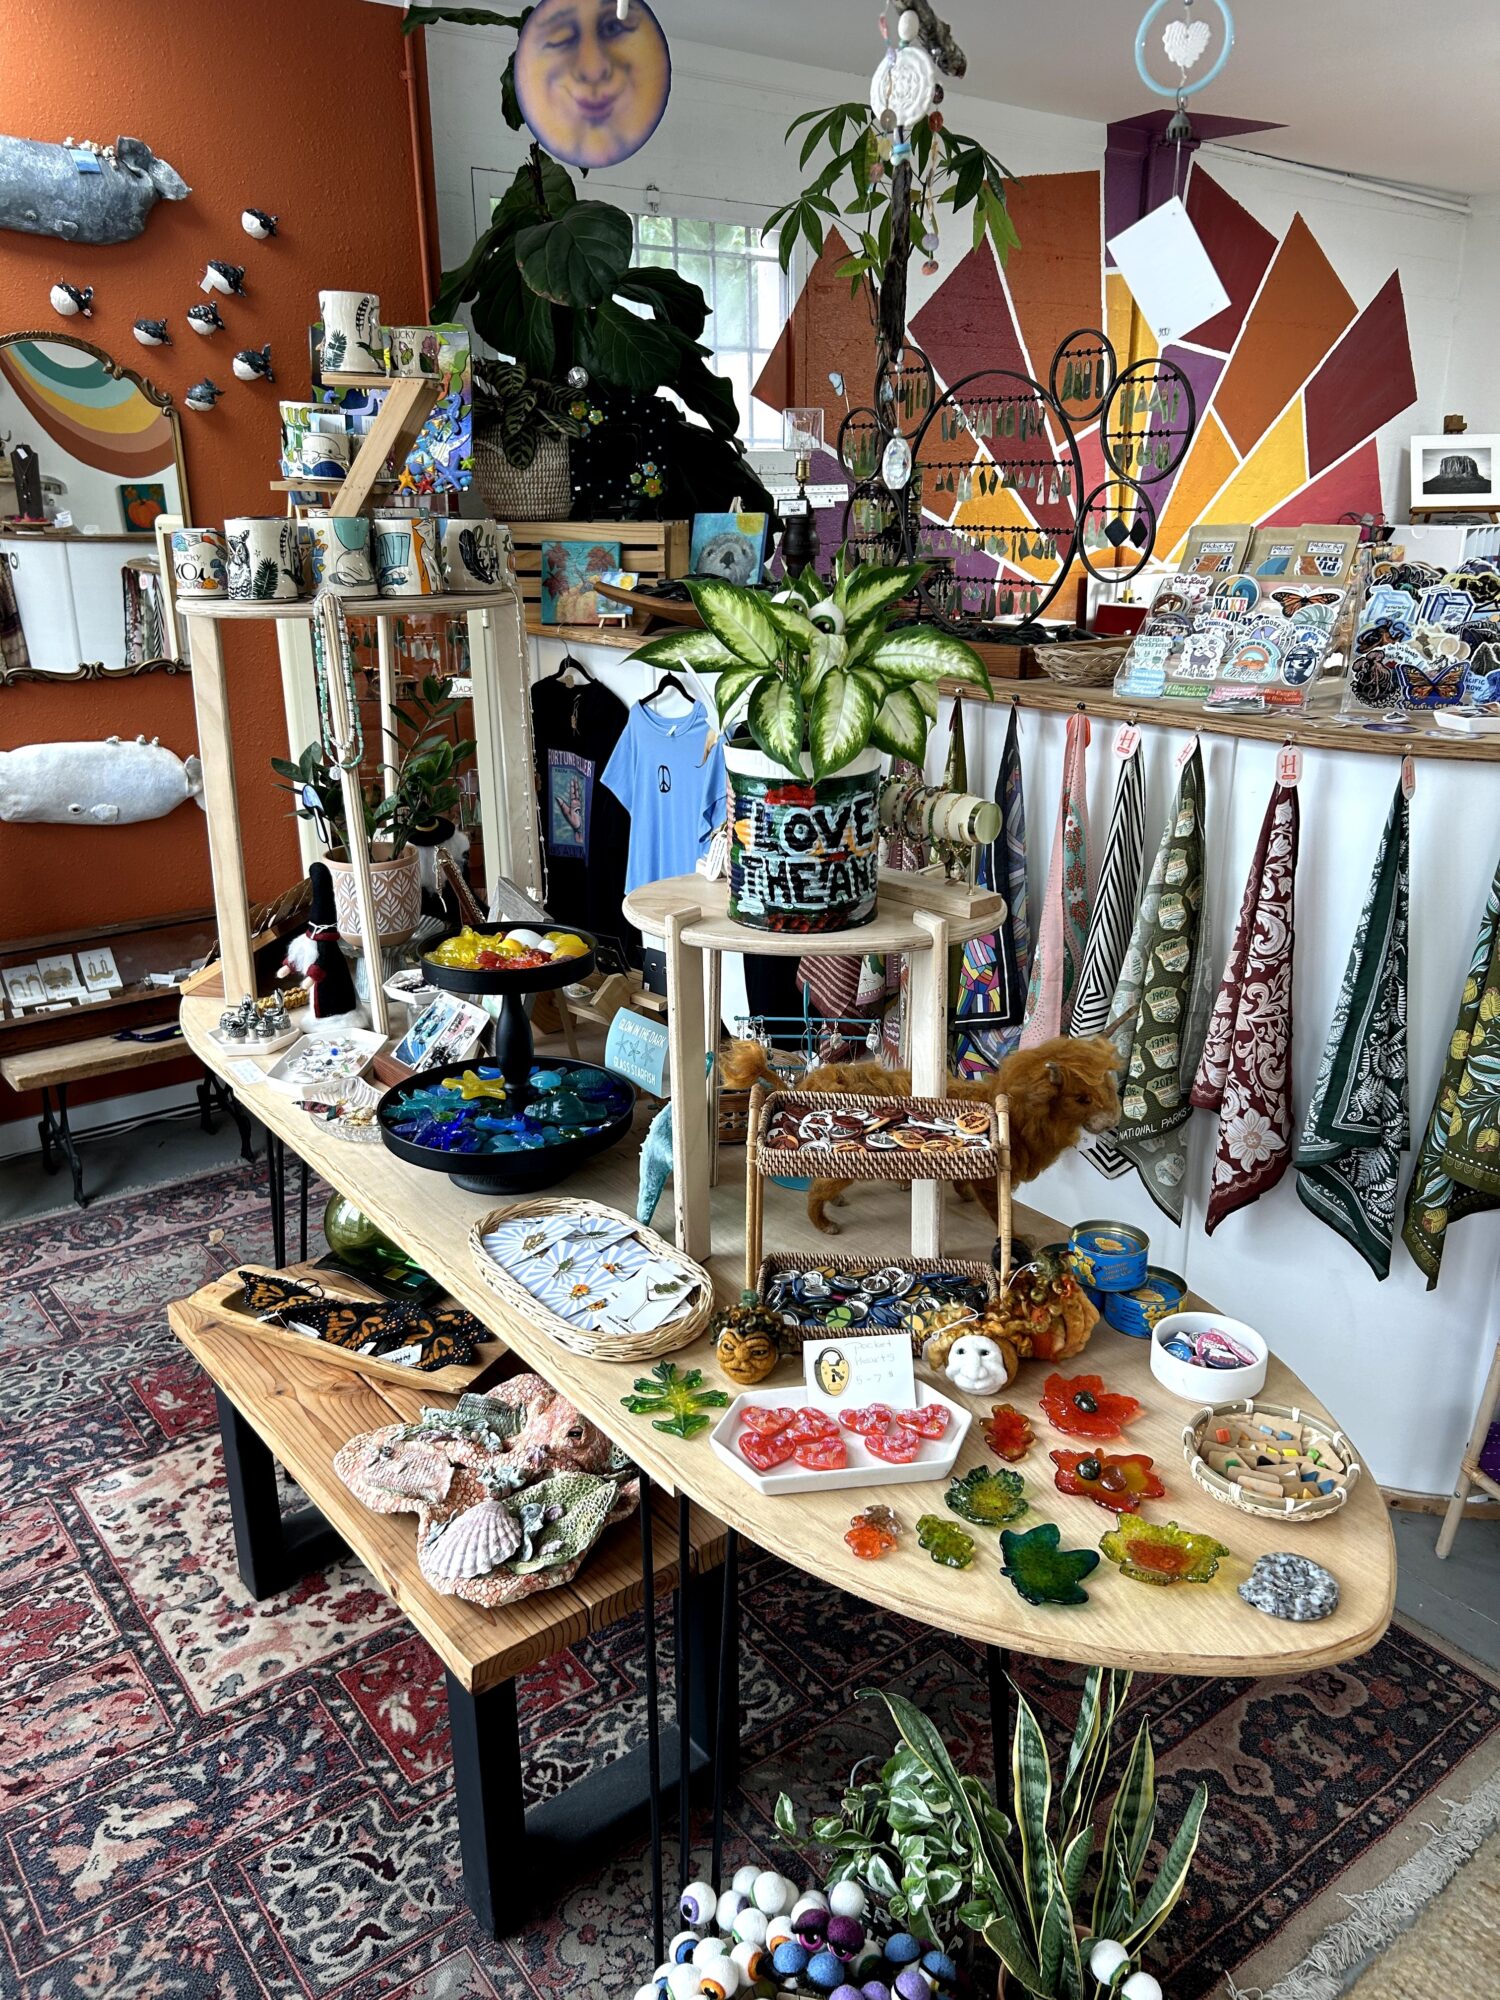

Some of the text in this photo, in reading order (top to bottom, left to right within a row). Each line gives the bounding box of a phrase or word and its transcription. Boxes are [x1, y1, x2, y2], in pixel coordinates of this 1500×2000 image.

[1174, 575, 1188, 584] Cat
[1213, 597, 1247, 611] MAKE
[1245, 619, 1281, 637] SILLY GOOSE
[547, 749, 577, 767] FORTUNE
[746, 790, 878, 857] LOVE
[618, 1017, 635, 1033] GLOW
[648, 1031, 667, 1049] DARK
[1150, 1035, 1171, 1048] 1994
[612, 1055, 657, 1086] GLASS STARFISH
[1119, 1123, 1158, 1141] NATIONAL
